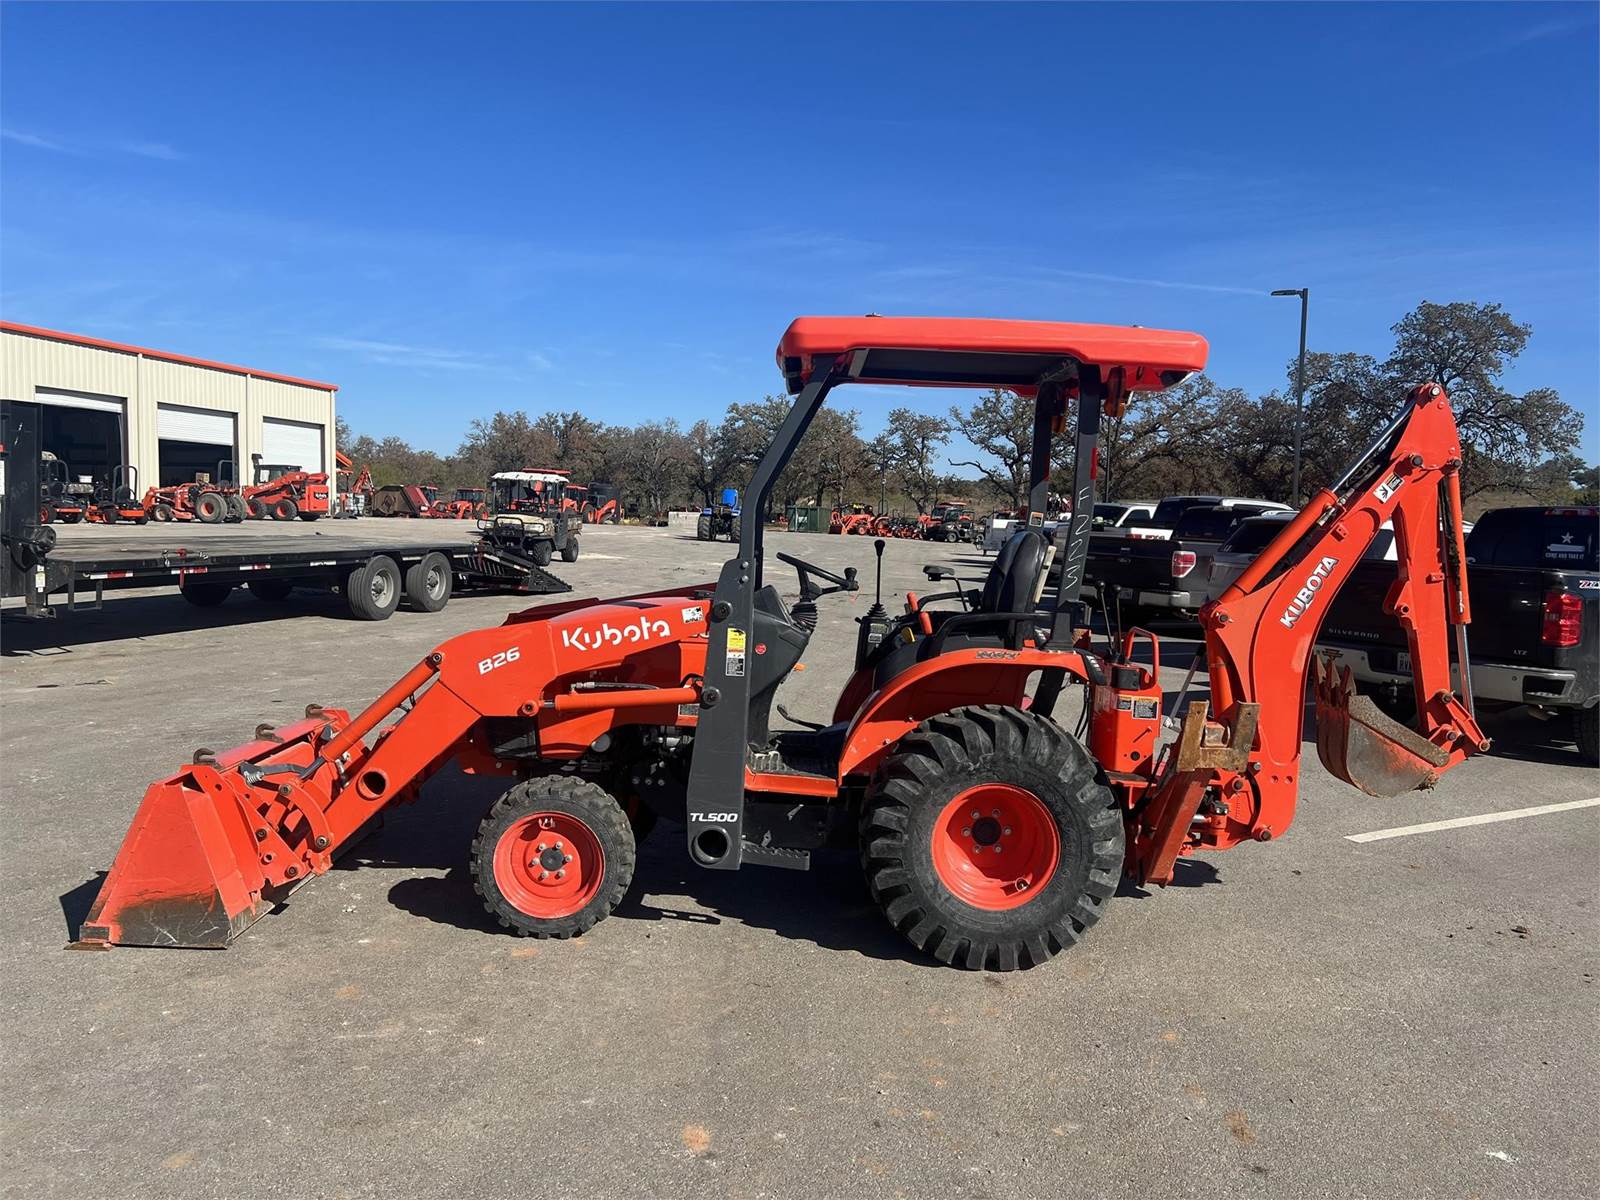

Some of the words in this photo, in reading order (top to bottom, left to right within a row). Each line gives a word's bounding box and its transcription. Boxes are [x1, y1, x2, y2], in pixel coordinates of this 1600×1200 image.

[1279, 556, 1340, 630] KUBOTA
[562, 616, 670, 651] Kubota
[1328, 627, 1380, 639] SILVERADO
[478, 647, 521, 675] B26
[690, 812, 738, 823] TL500
